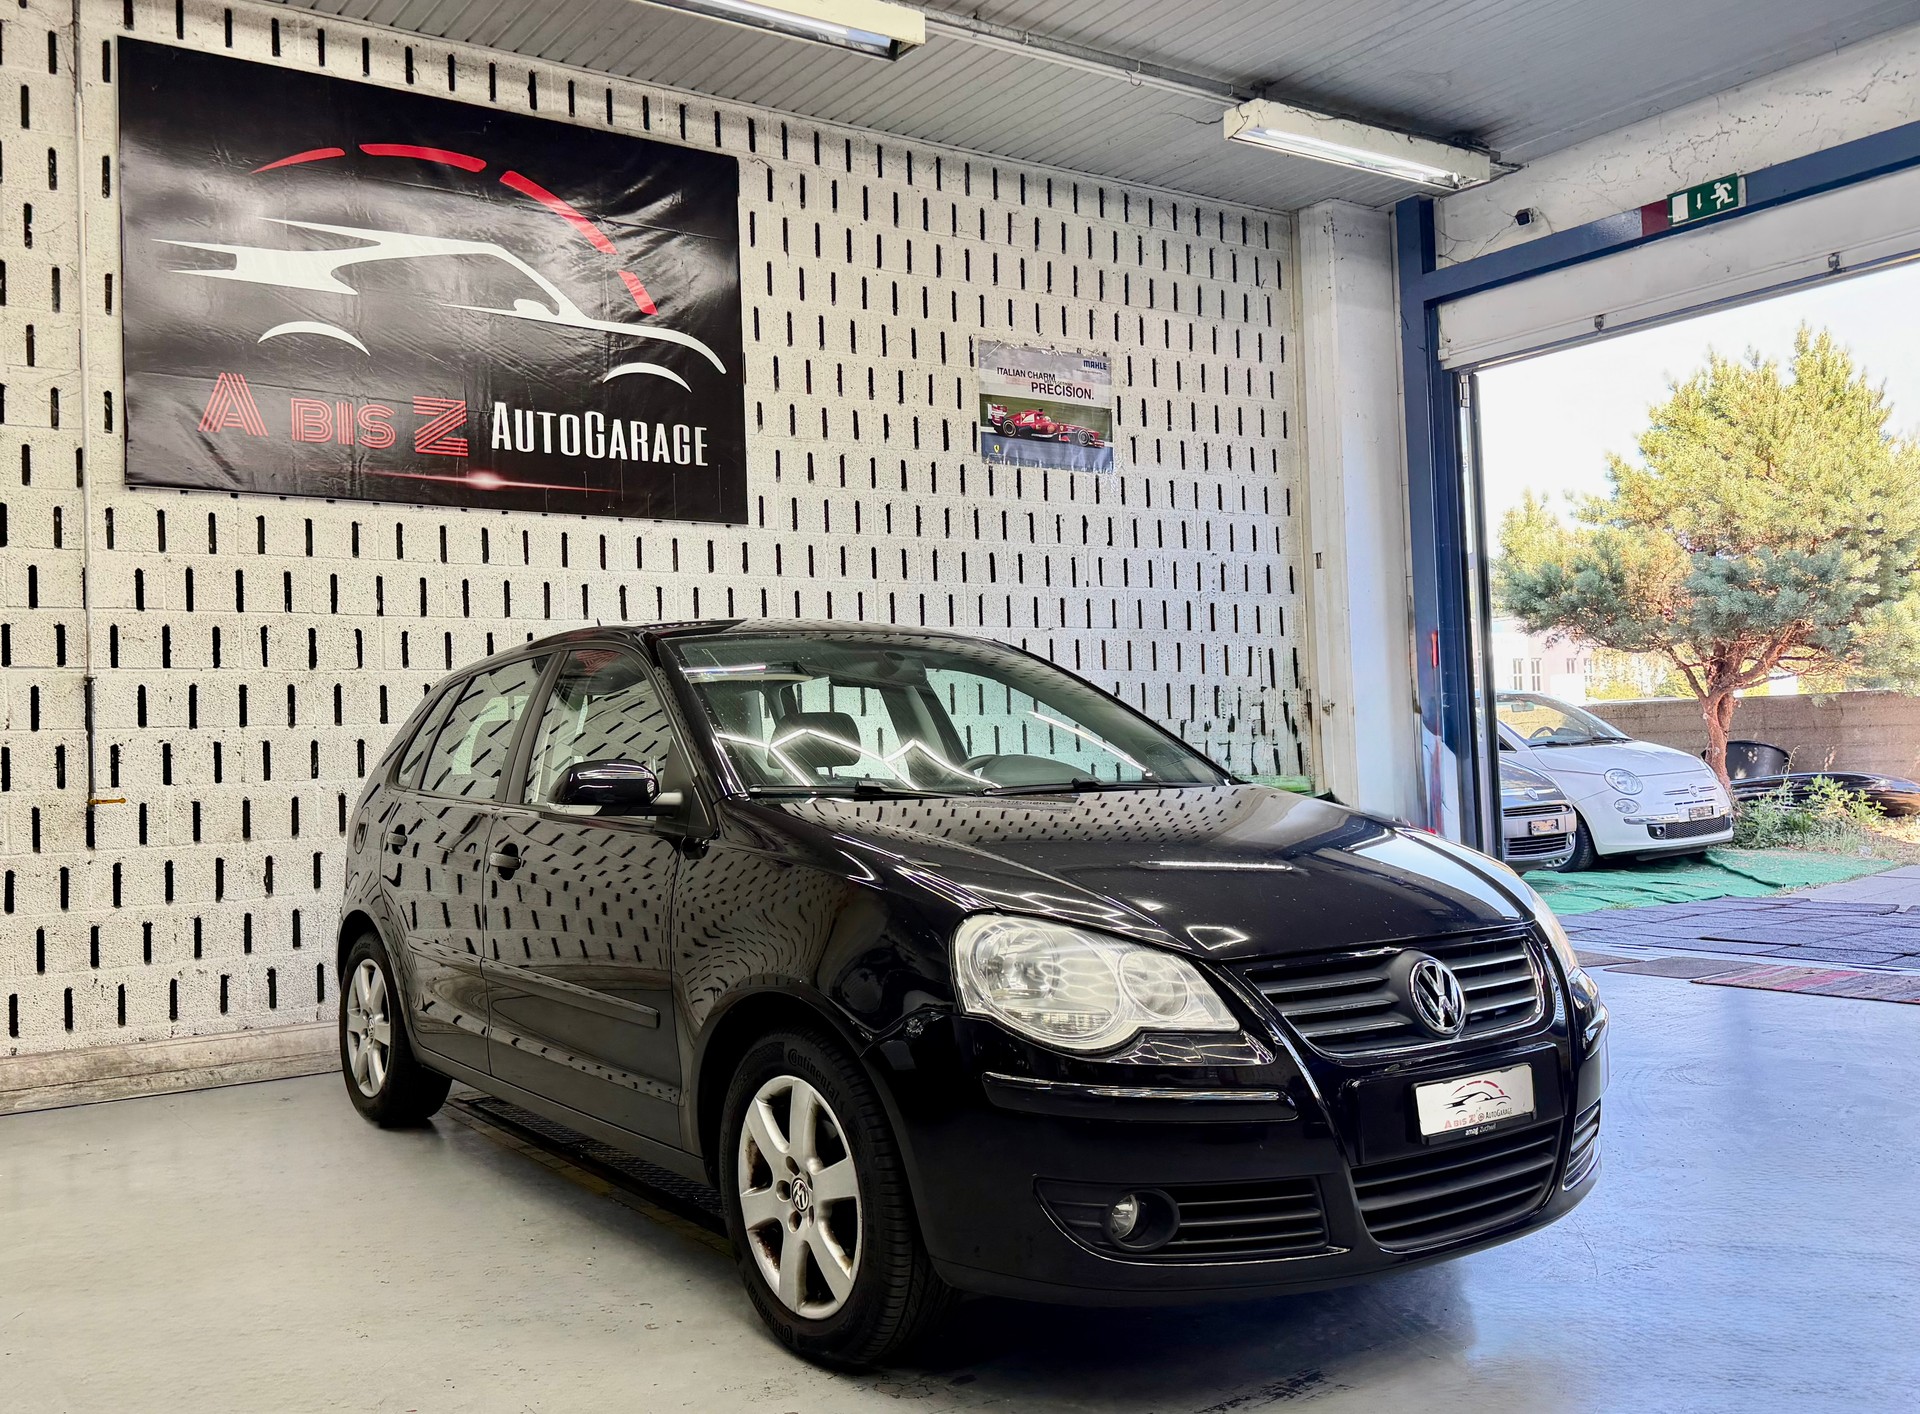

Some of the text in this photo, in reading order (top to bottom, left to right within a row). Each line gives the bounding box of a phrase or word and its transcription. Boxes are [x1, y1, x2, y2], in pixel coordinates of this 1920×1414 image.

[1083, 360, 1107, 371] MAHLE
[997, 367, 1056, 381] ITALIAN CHARM
[1031, 382, 1095, 400] PRECISION.
[198, 372, 269, 437] A
[290, 397, 396, 449] BIS
[412, 395, 468, 457] Z
[788, 1048, 840, 1104] Continental
[1444, 1120, 1452, 1129] A
